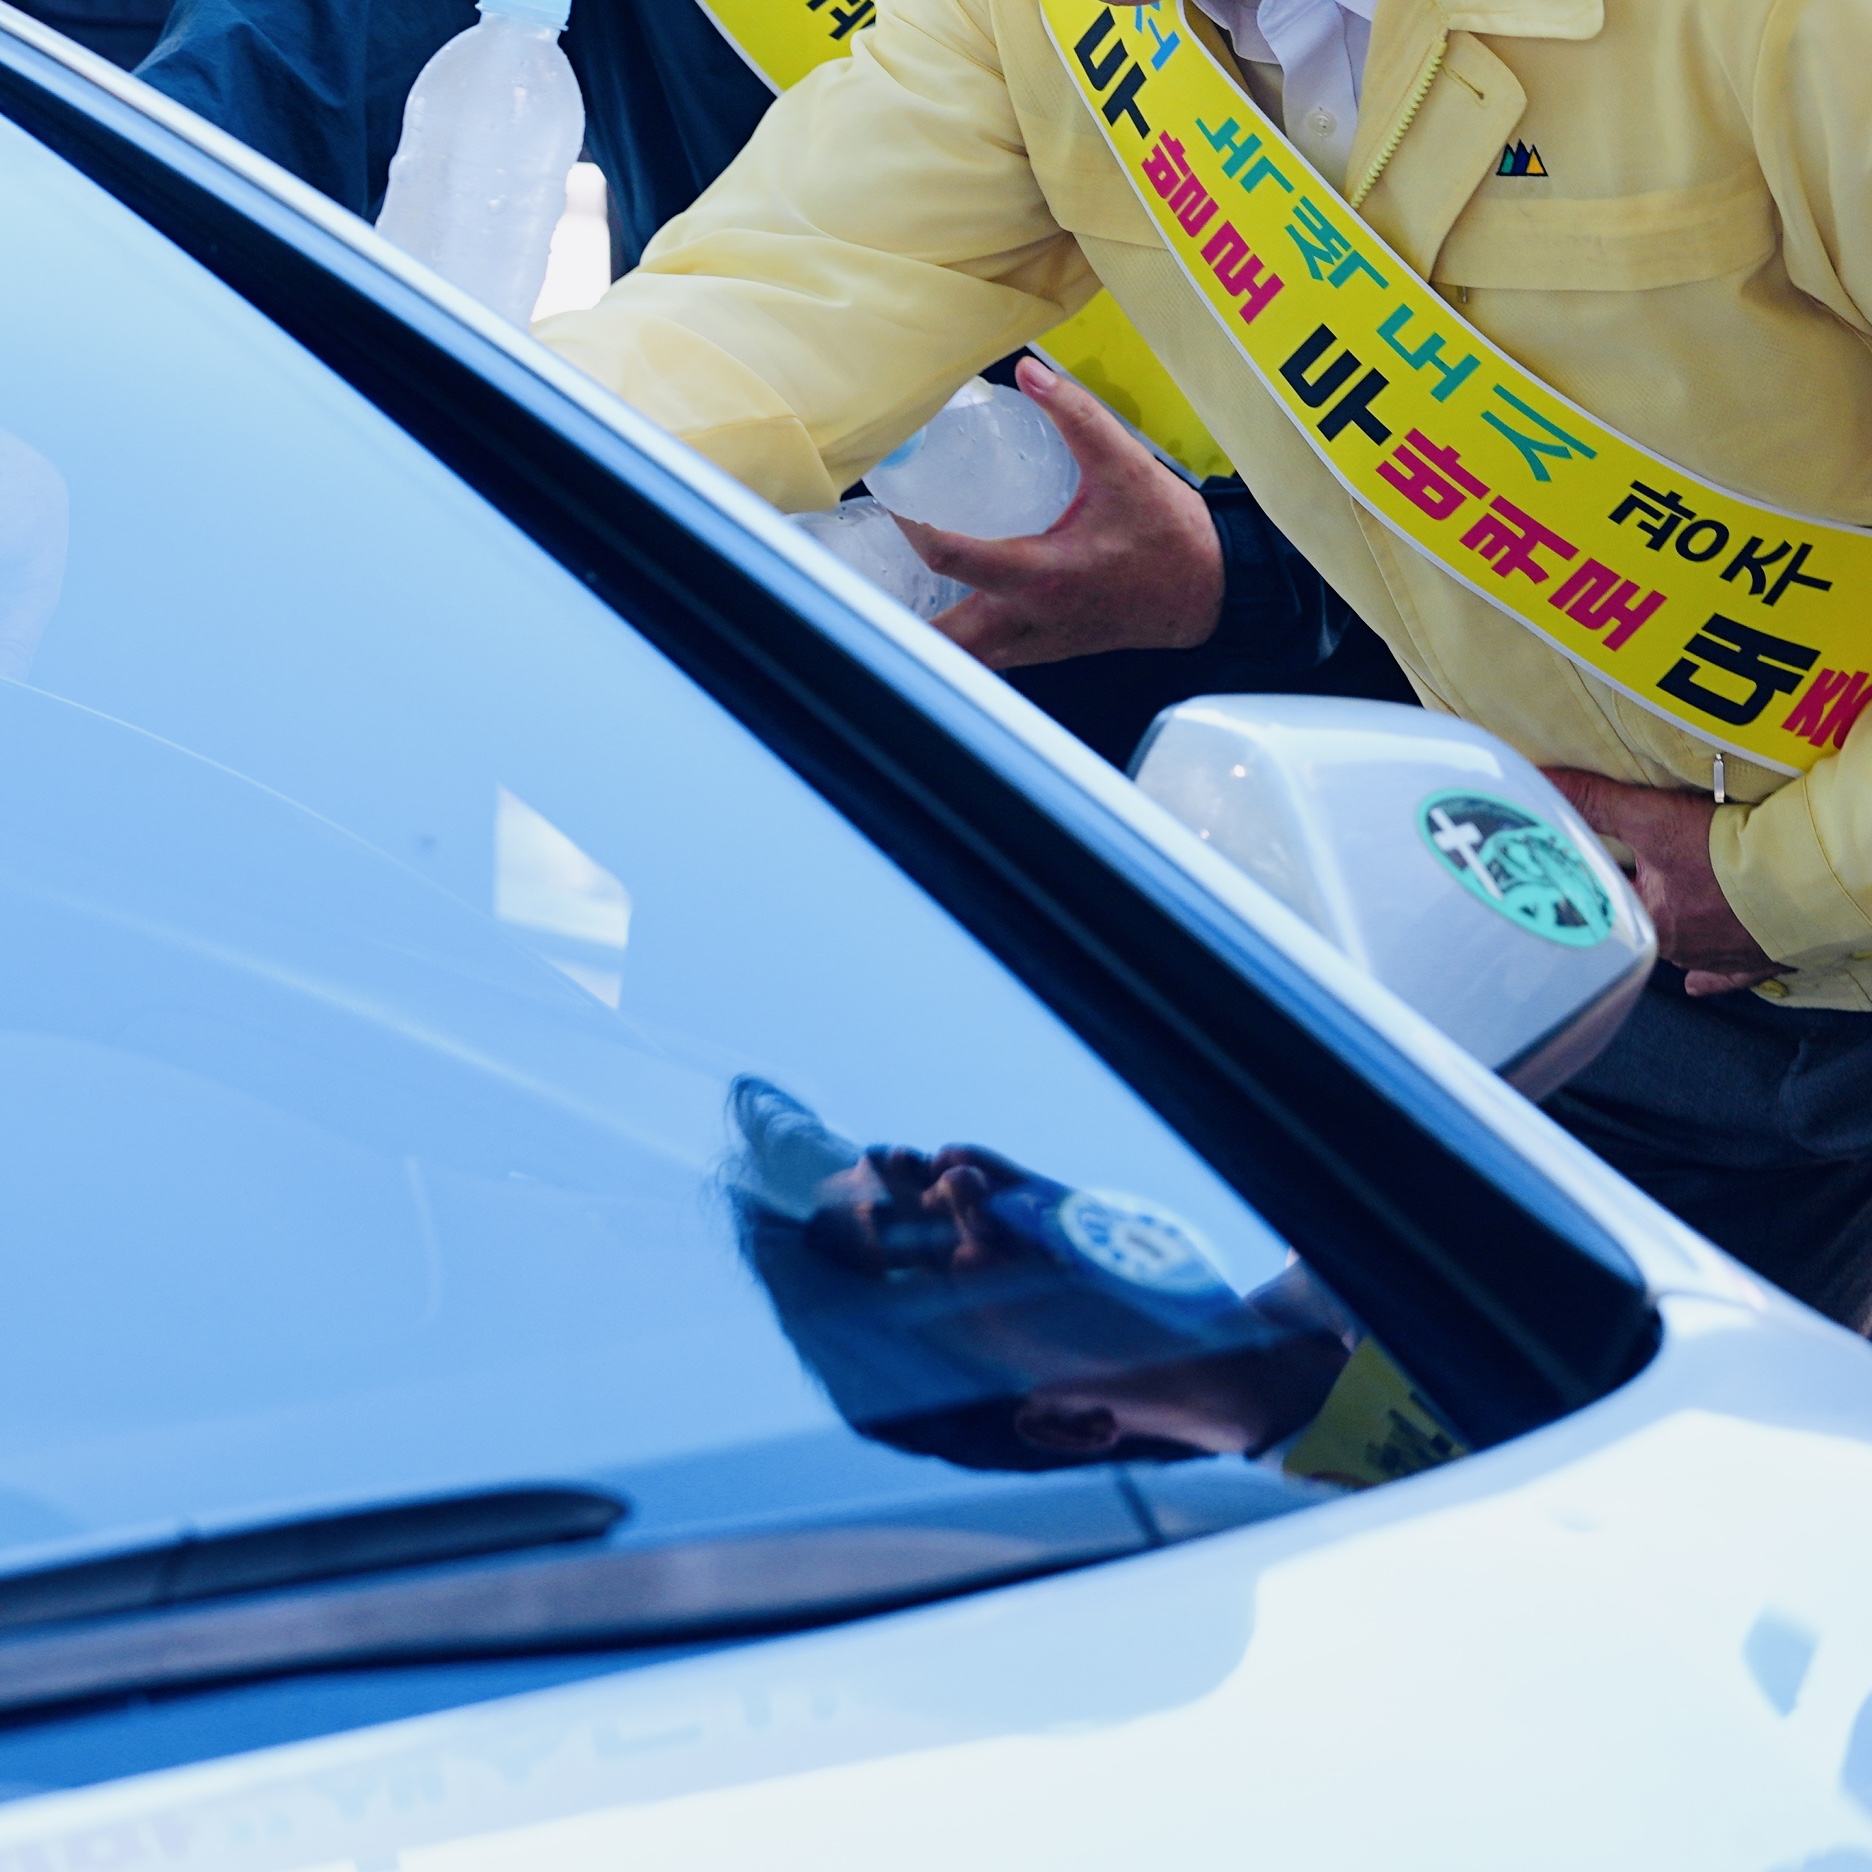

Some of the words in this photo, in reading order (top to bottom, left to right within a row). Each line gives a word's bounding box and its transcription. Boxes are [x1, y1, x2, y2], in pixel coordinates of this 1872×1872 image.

[1072, 7, 1285, 325] 두발로
[1279, 323, 1668, 652] 두바퀴로
[1195, 118, 1598, 483] 녹색도시
[1607, 479, 1834, 607] 광주
